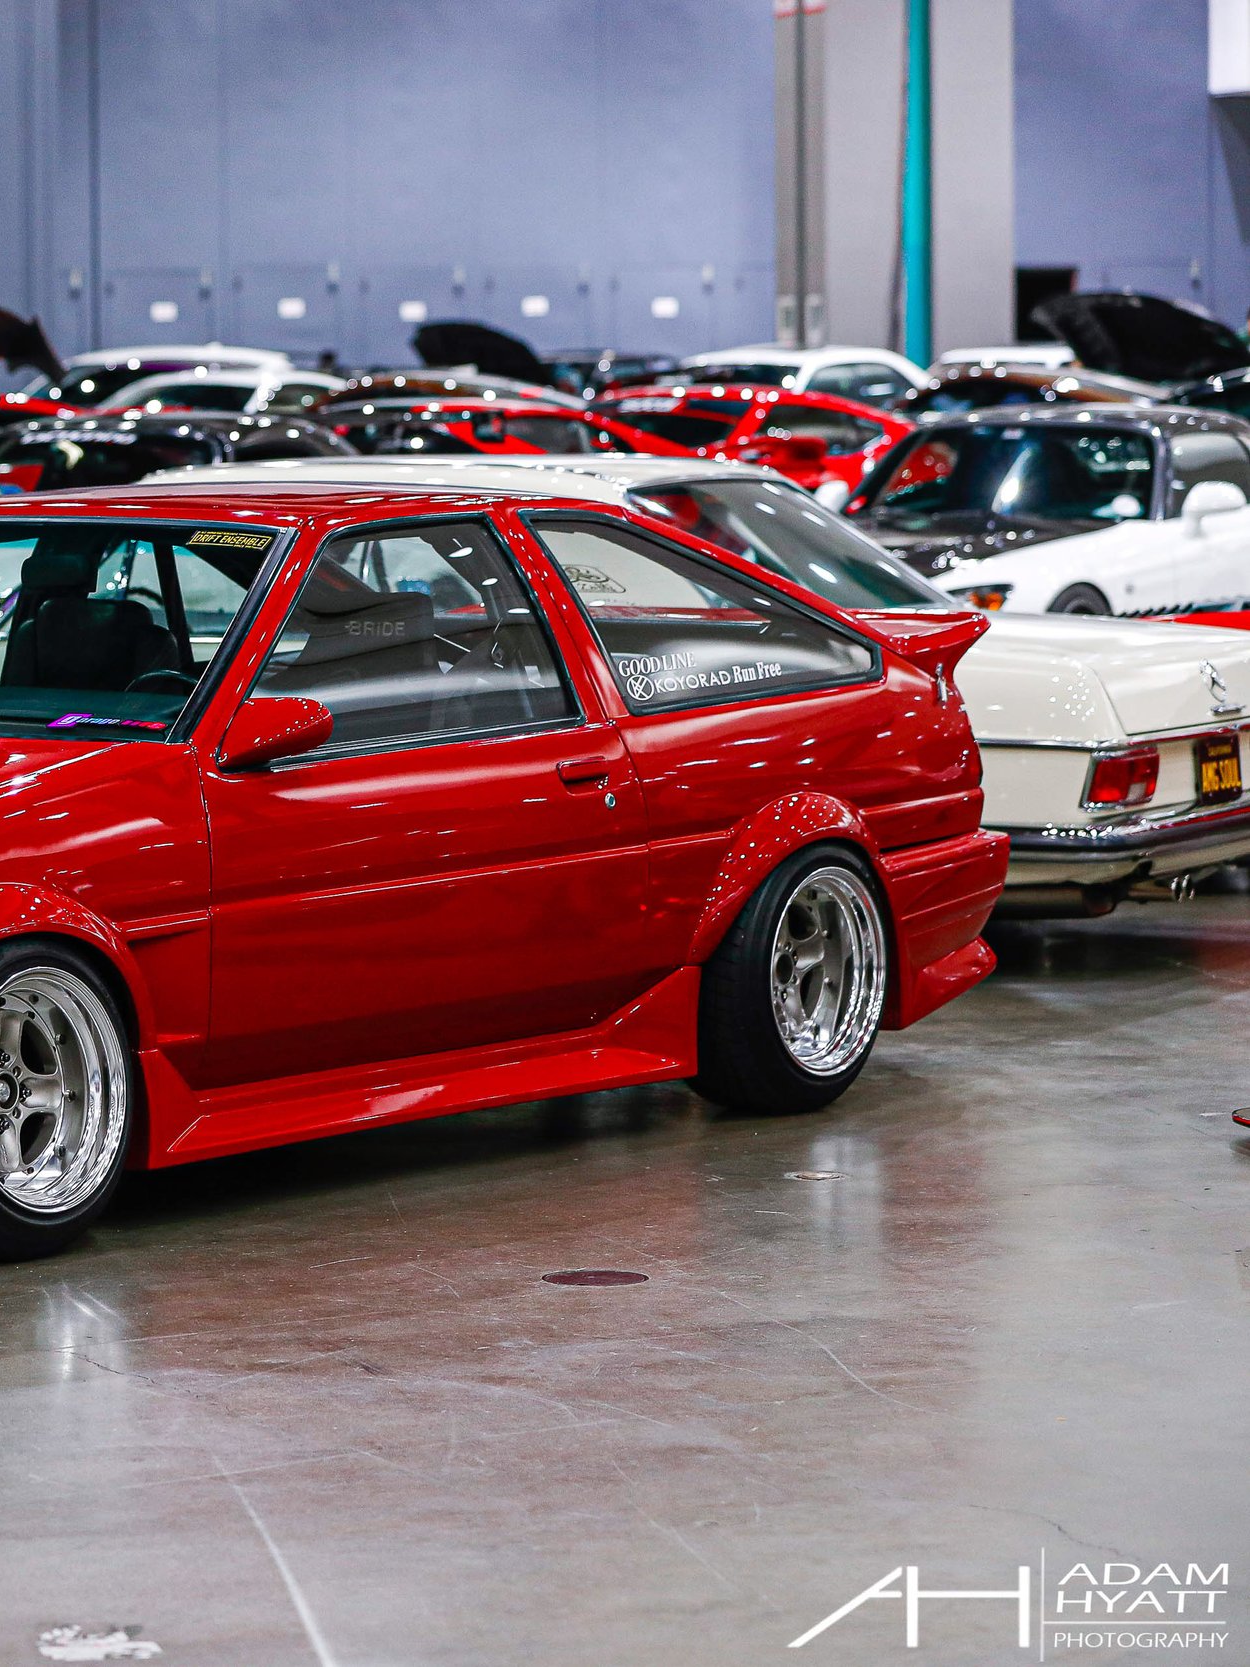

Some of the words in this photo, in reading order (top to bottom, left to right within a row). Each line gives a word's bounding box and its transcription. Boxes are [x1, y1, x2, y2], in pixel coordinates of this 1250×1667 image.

[193, 533, 223, 543] DRIFT
[220, 535, 268, 547] ENSEMBLE
[348, 620, 406, 636] BRIDE
[655, 670, 731, 694] KOYORAD
[732, 665, 757, 684] Run
[756, 661, 783, 680] Free
